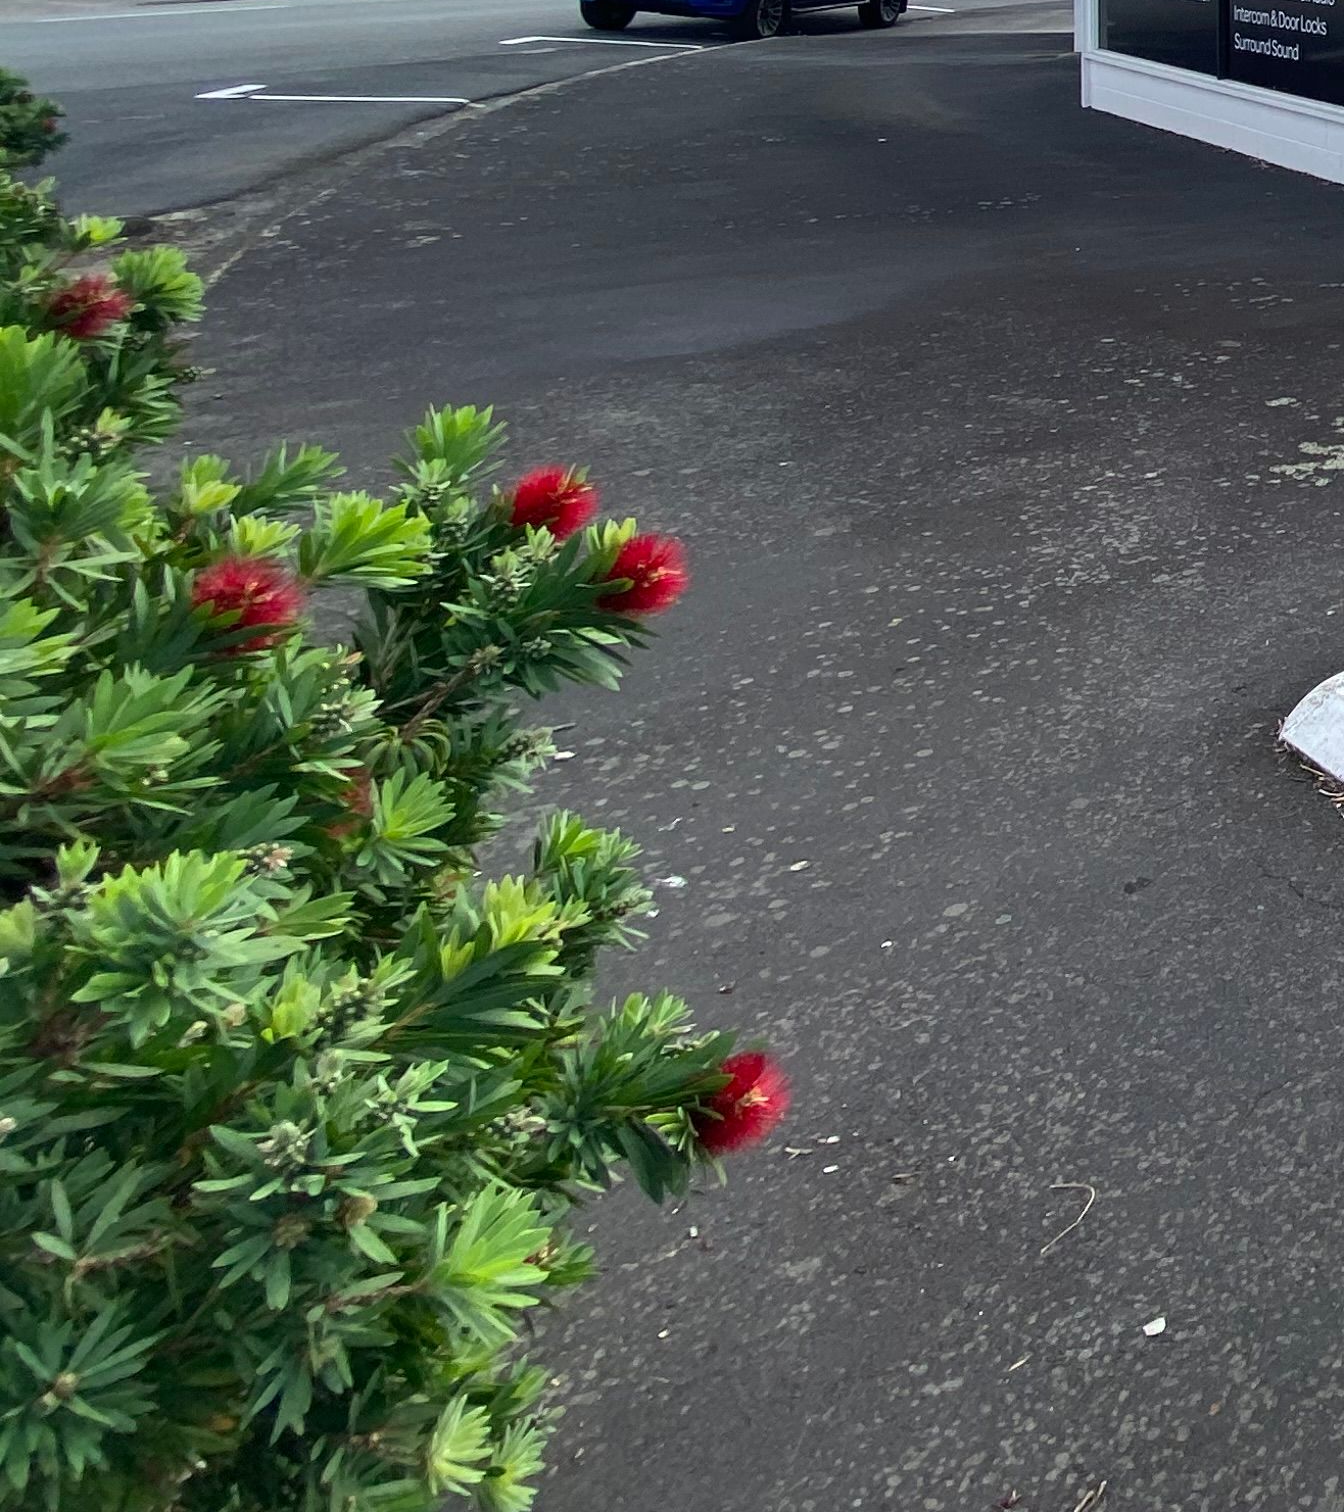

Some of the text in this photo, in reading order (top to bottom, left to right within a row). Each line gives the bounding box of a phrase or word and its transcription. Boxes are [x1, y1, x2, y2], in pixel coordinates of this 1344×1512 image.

[1233, 5, 1327, 36] Intercom & Door Locks
[1234, 32, 1299, 60] Surround Sound
